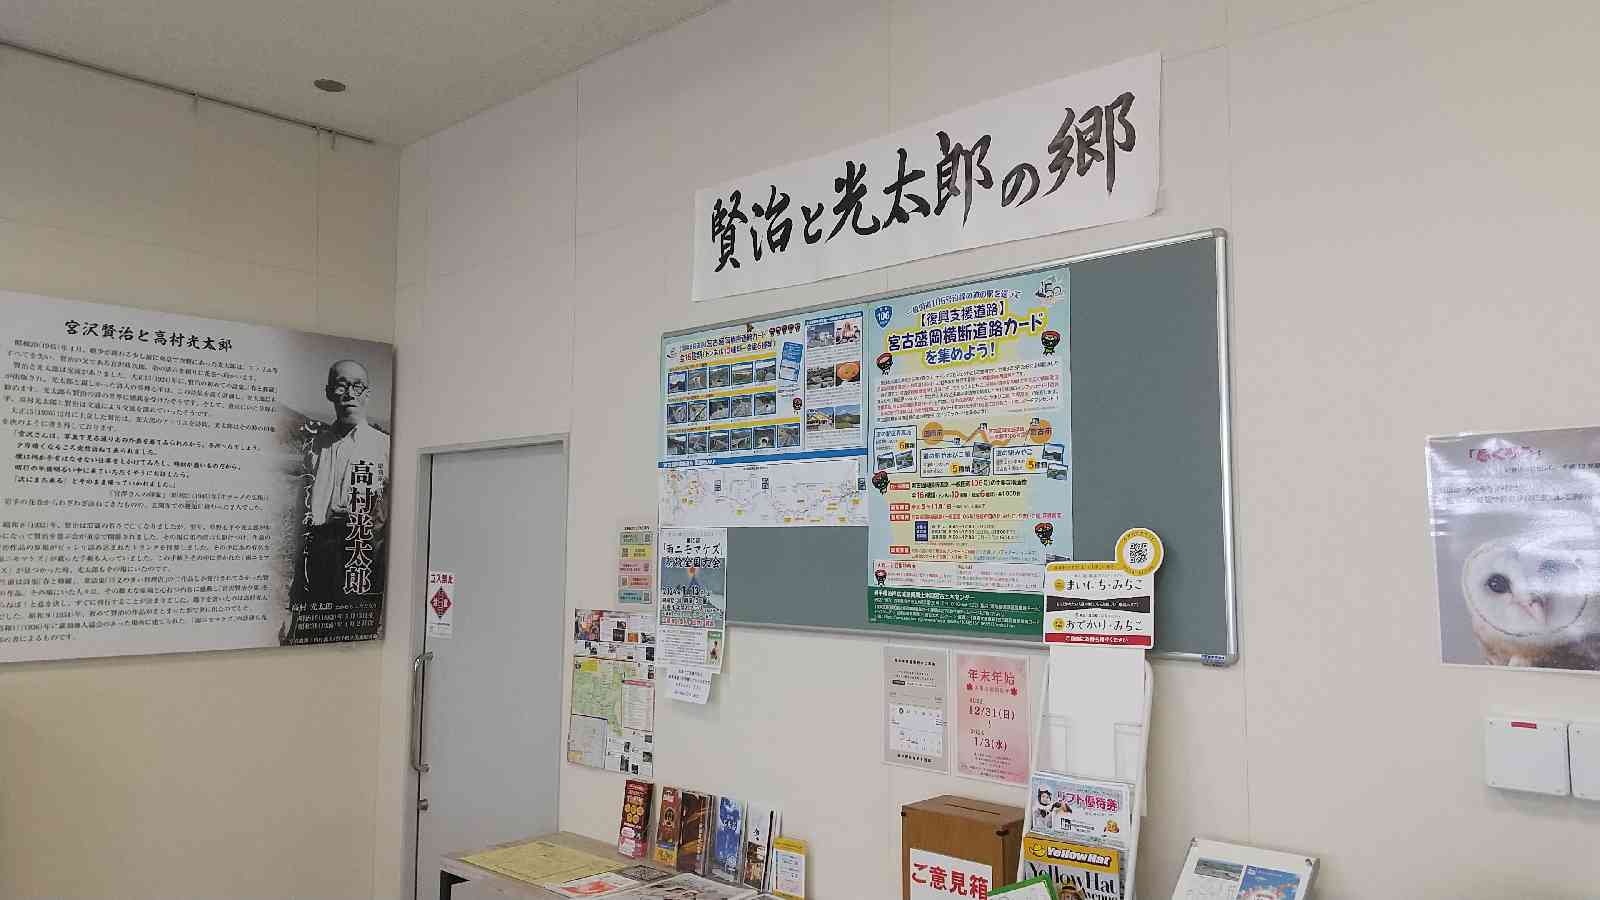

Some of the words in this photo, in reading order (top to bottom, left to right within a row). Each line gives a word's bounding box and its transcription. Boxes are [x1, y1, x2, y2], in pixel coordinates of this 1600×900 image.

[710, 91, 1137, 273] 賢治と光太郎の郷
[64, 319, 233, 353] 宮沢賢治と高村光太郎
[887, 312, 1044, 351] 宮古盛岡横断道路カード
[343, 459, 375, 595] 高村光太郎
[967, 668, 1016, 686] 年末年始
[968, 704, 1015, 721] 12/31(日)
[1057, 790, 1118, 812] リフト優待券
[911, 862, 990, 900] ご意見箱
